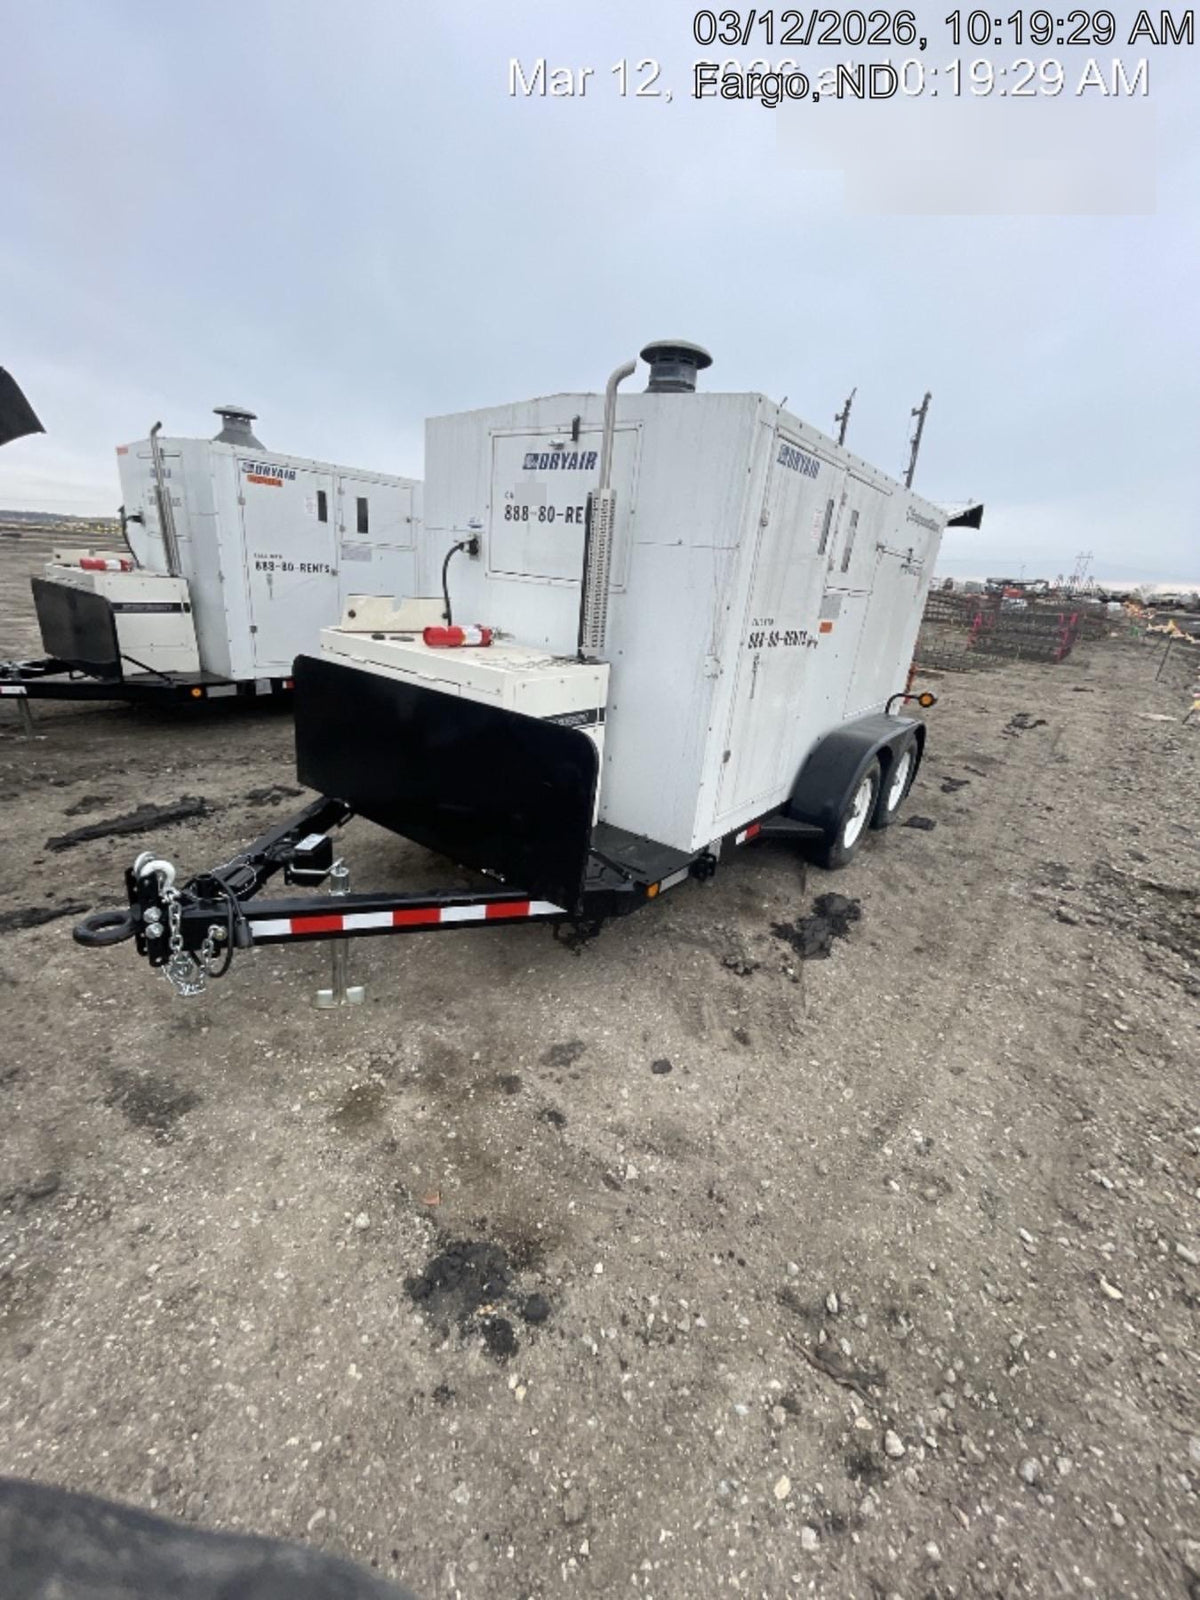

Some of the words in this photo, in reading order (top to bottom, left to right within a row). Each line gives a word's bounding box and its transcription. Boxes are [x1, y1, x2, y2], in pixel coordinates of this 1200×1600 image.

[539, 451, 597, 470] DRYAIR
[255, 464, 296, 480] DRYAIR
[504, 504, 584, 523] 888-80-RE
